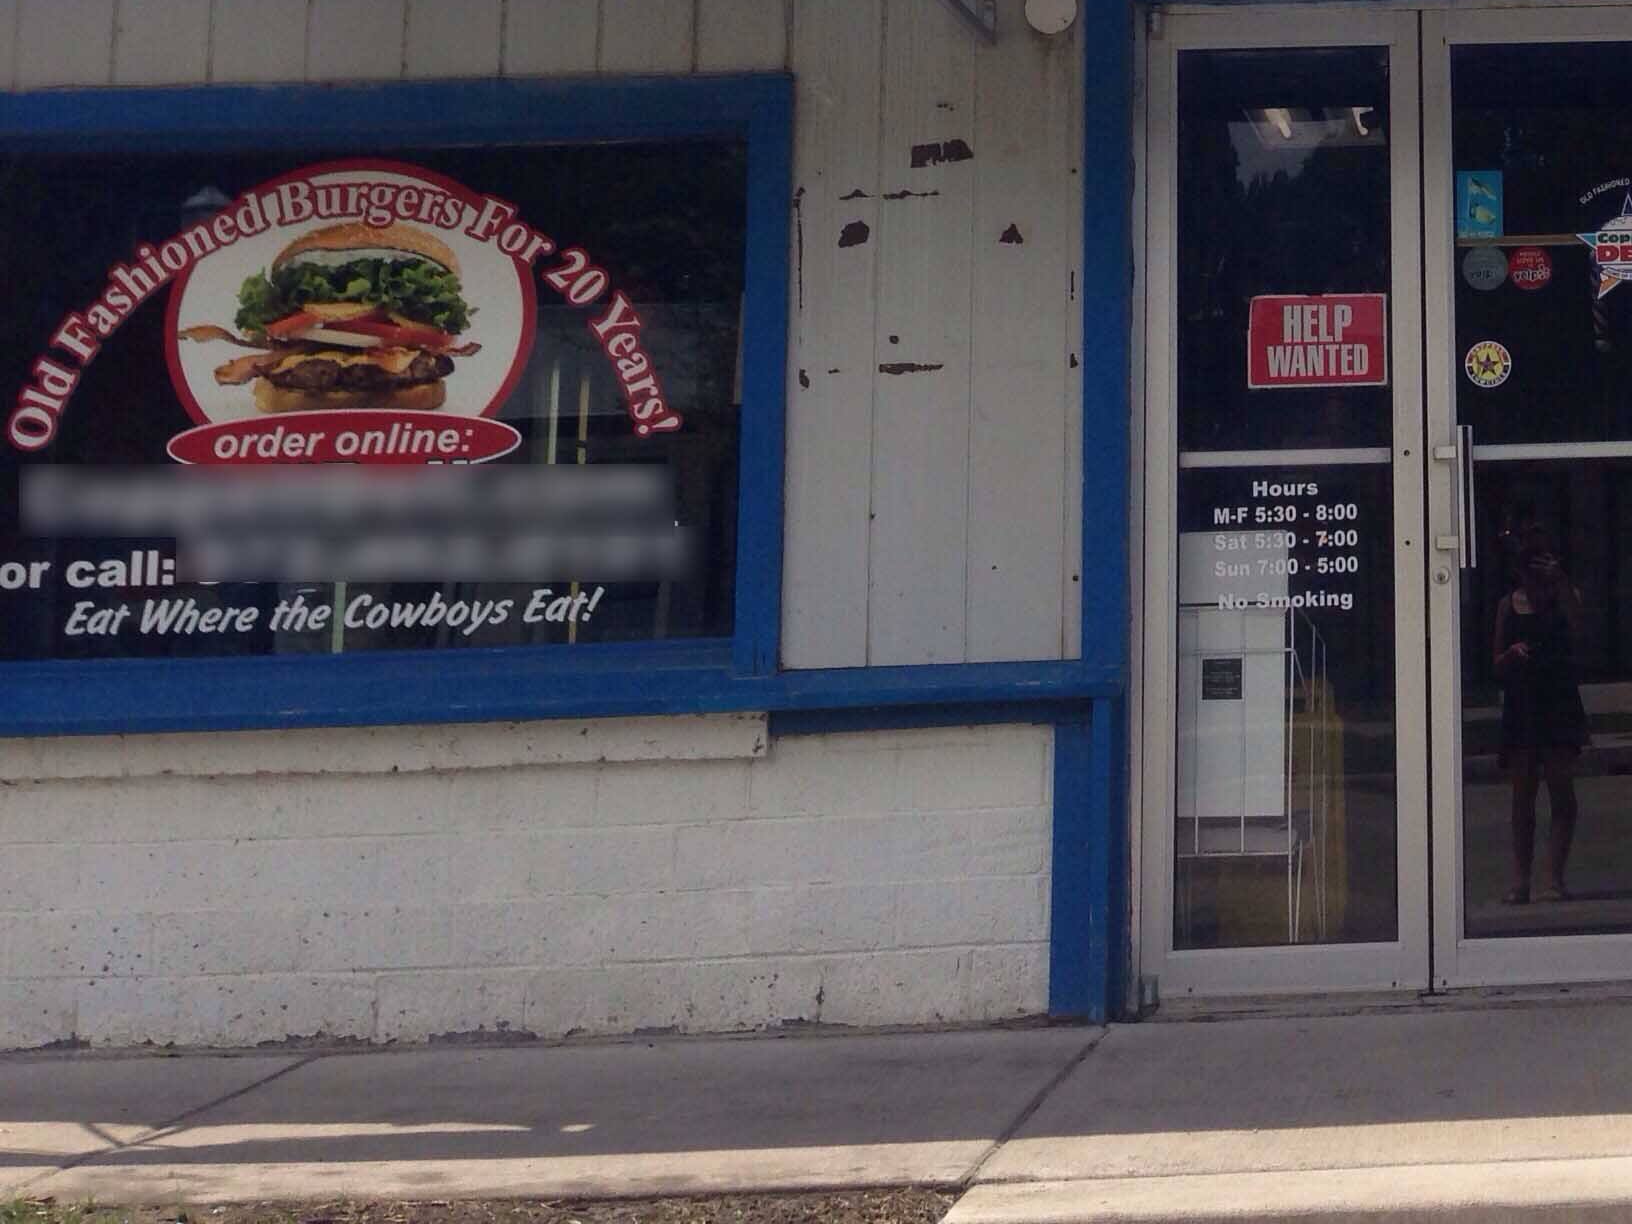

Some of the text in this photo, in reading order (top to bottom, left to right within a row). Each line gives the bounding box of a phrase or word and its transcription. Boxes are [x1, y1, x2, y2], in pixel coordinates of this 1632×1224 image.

[8, 179, 682, 450] Old Fashioned Burgers For 20 Years!
[1282, 304, 1353, 343] HELP
[1266, 343, 1369, 378] WANTED
[214, 422, 474, 458] order online:
[1252, 480, 1319, 498] Hours
[1213, 507, 1249, 525] M-F
[1254, 505, 1297, 523] 5:30
[1315, 503, 1358, 521] 8:00
[1215, 533, 1247, 551] Sat
[1255, 532, 1297, 550] 5:30
[1315, 530, 1358, 548] 7:00
[0, 557, 49, 590] or
[64, 549, 176, 587] call:
[1214, 560, 1250, 577] Sun
[1256, 558, 1298, 576] 7:00
[1316, 556, 1358, 575] 5:00
[65, 586, 605, 636] Eat Where the Cowboys Eat!
[1218, 590, 1354, 612] No Smoking
